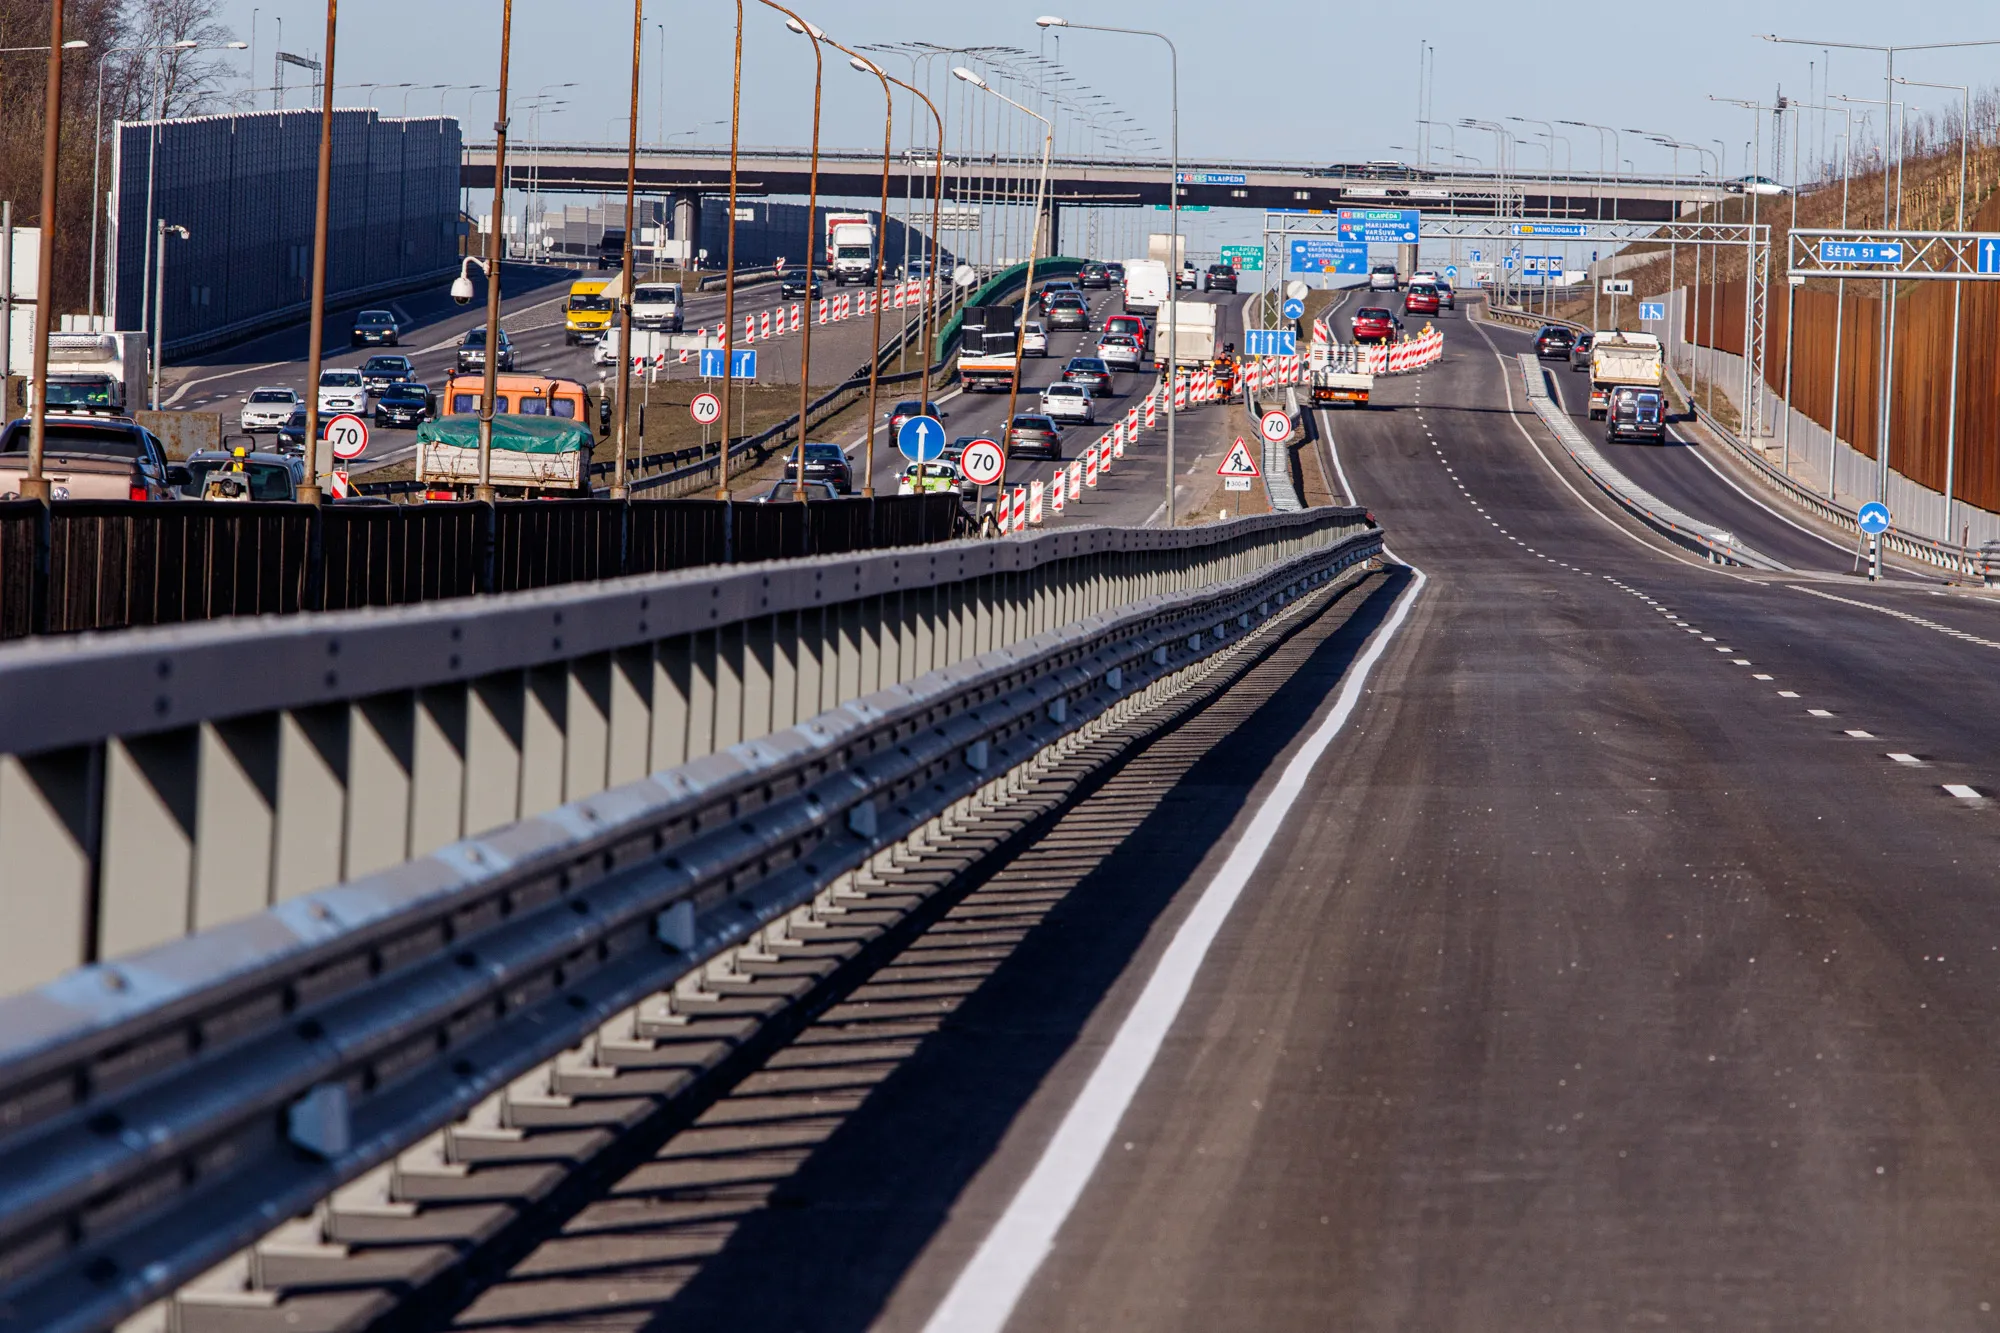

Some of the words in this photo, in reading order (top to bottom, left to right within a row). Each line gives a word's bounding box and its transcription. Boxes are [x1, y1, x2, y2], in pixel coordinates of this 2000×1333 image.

[1827, 245, 1856, 257] ŠĖTA
[1862, 248, 1874, 258] 51
[698, 403, 715, 415] 70
[1269, 420, 1284, 432] 70
[335, 428, 358, 445] 70
[972, 453, 995, 471] 70
